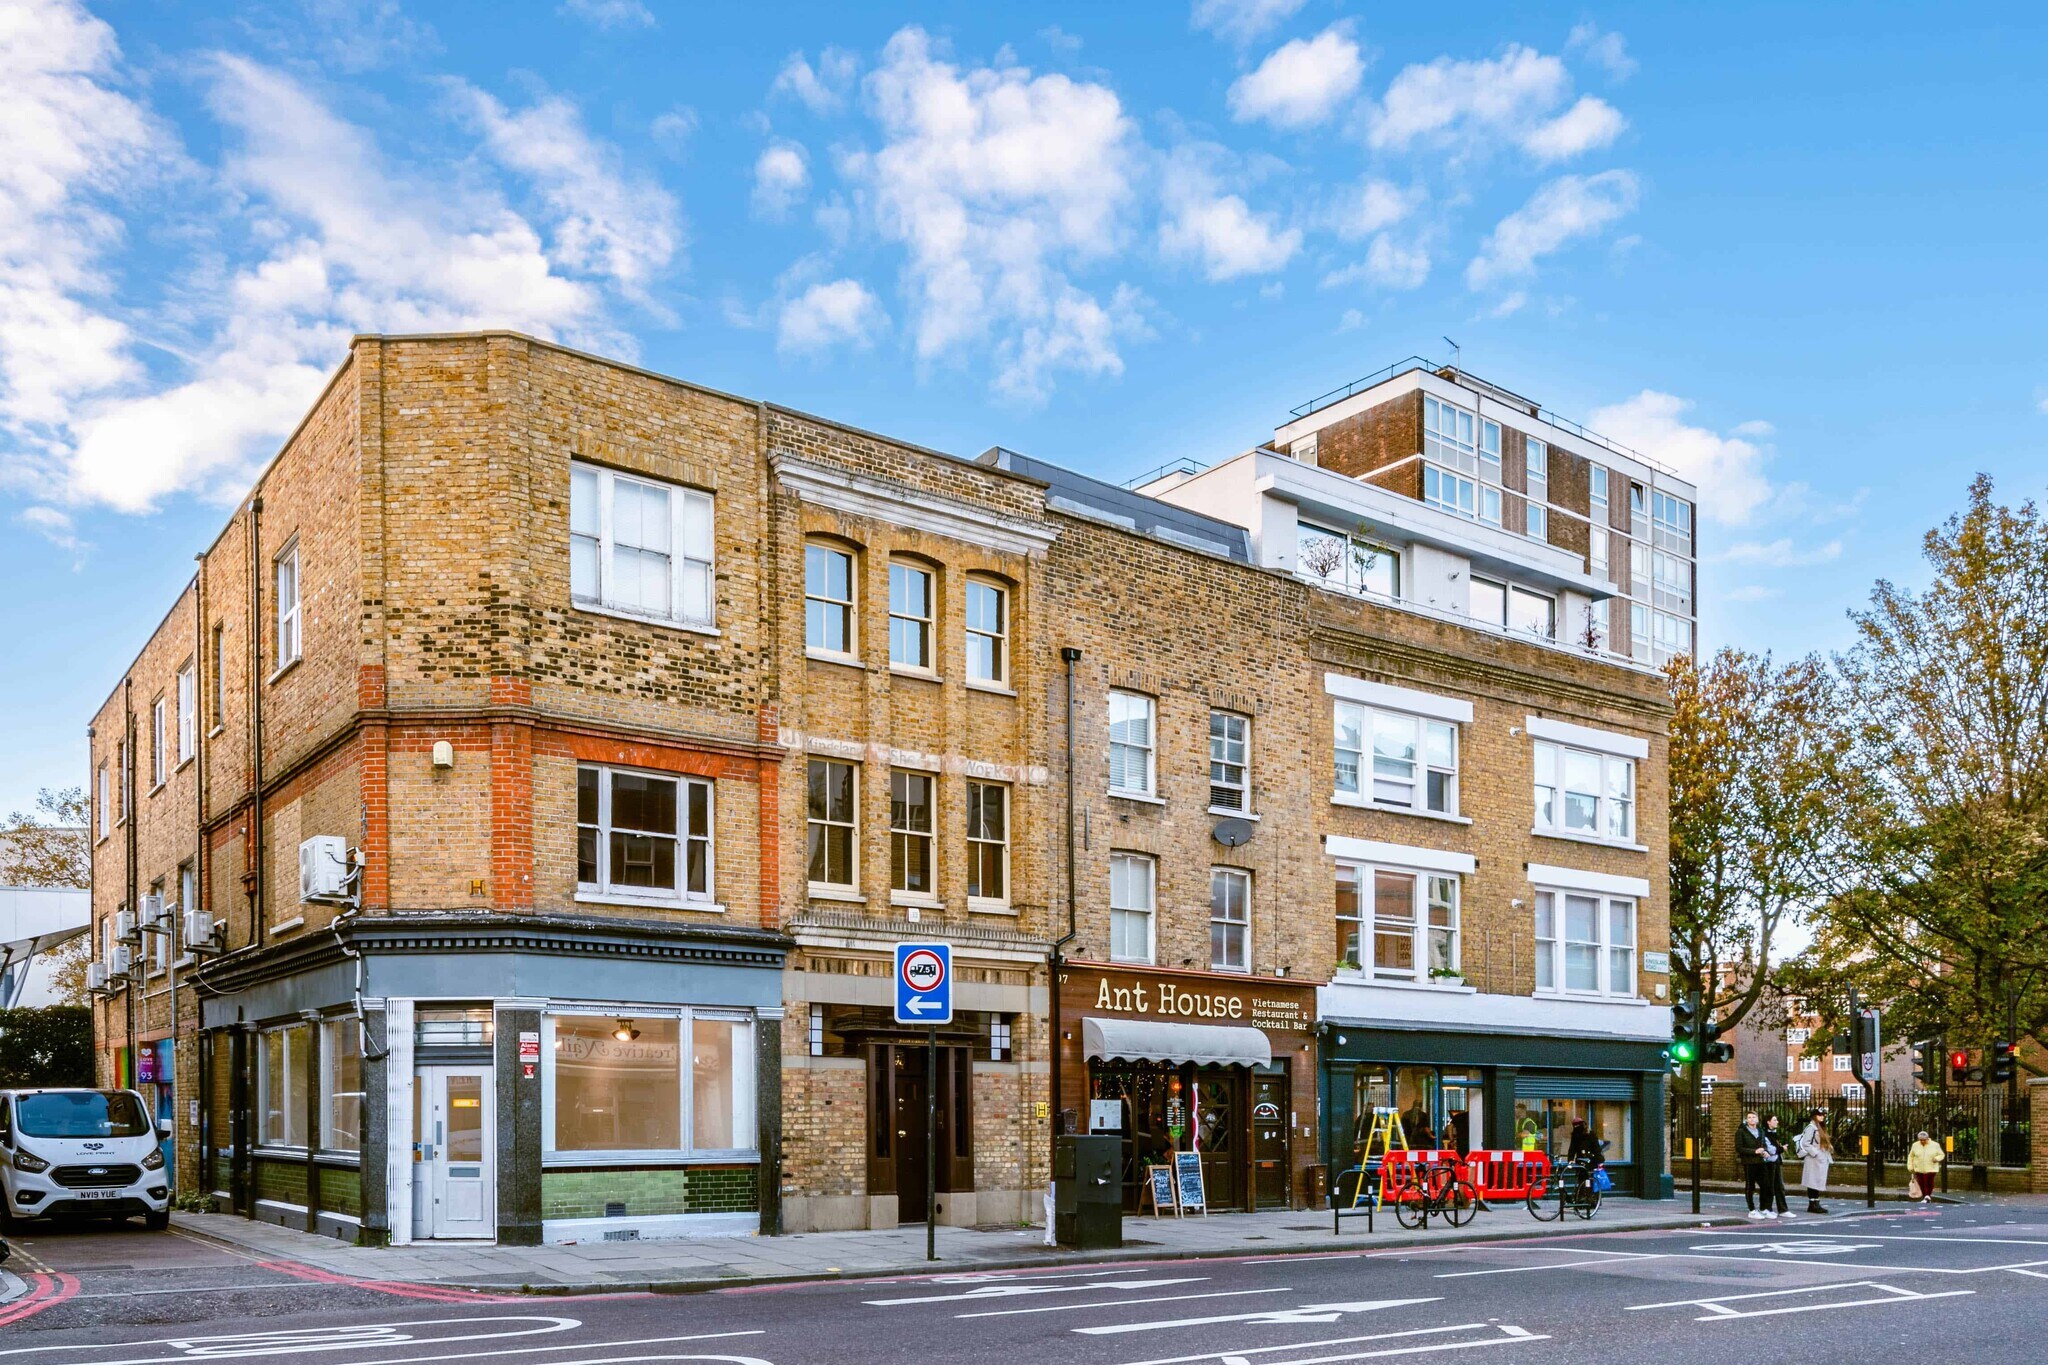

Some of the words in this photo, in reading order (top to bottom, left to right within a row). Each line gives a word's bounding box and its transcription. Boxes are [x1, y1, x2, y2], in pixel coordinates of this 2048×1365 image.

[471, 880, 483, 895] H
[1095, 977, 1149, 1013] Ant
[1157, 983, 1243, 1019] House
[1252, 998, 1300, 1010] Vietnamese
[1252, 1008, 1299, 1020] Restaurant
[1302, 1011, 1309, 1020] &
[1251, 1019, 1290, 1030] Cocktail
[1293, 1021, 1309, 1031] Bar
[140, 1071, 153, 1080] 93
[1037, 1103, 1046, 1116] H
[80, 1191, 99, 1199] NV19
[101, 1190, 117, 1199] YUE
